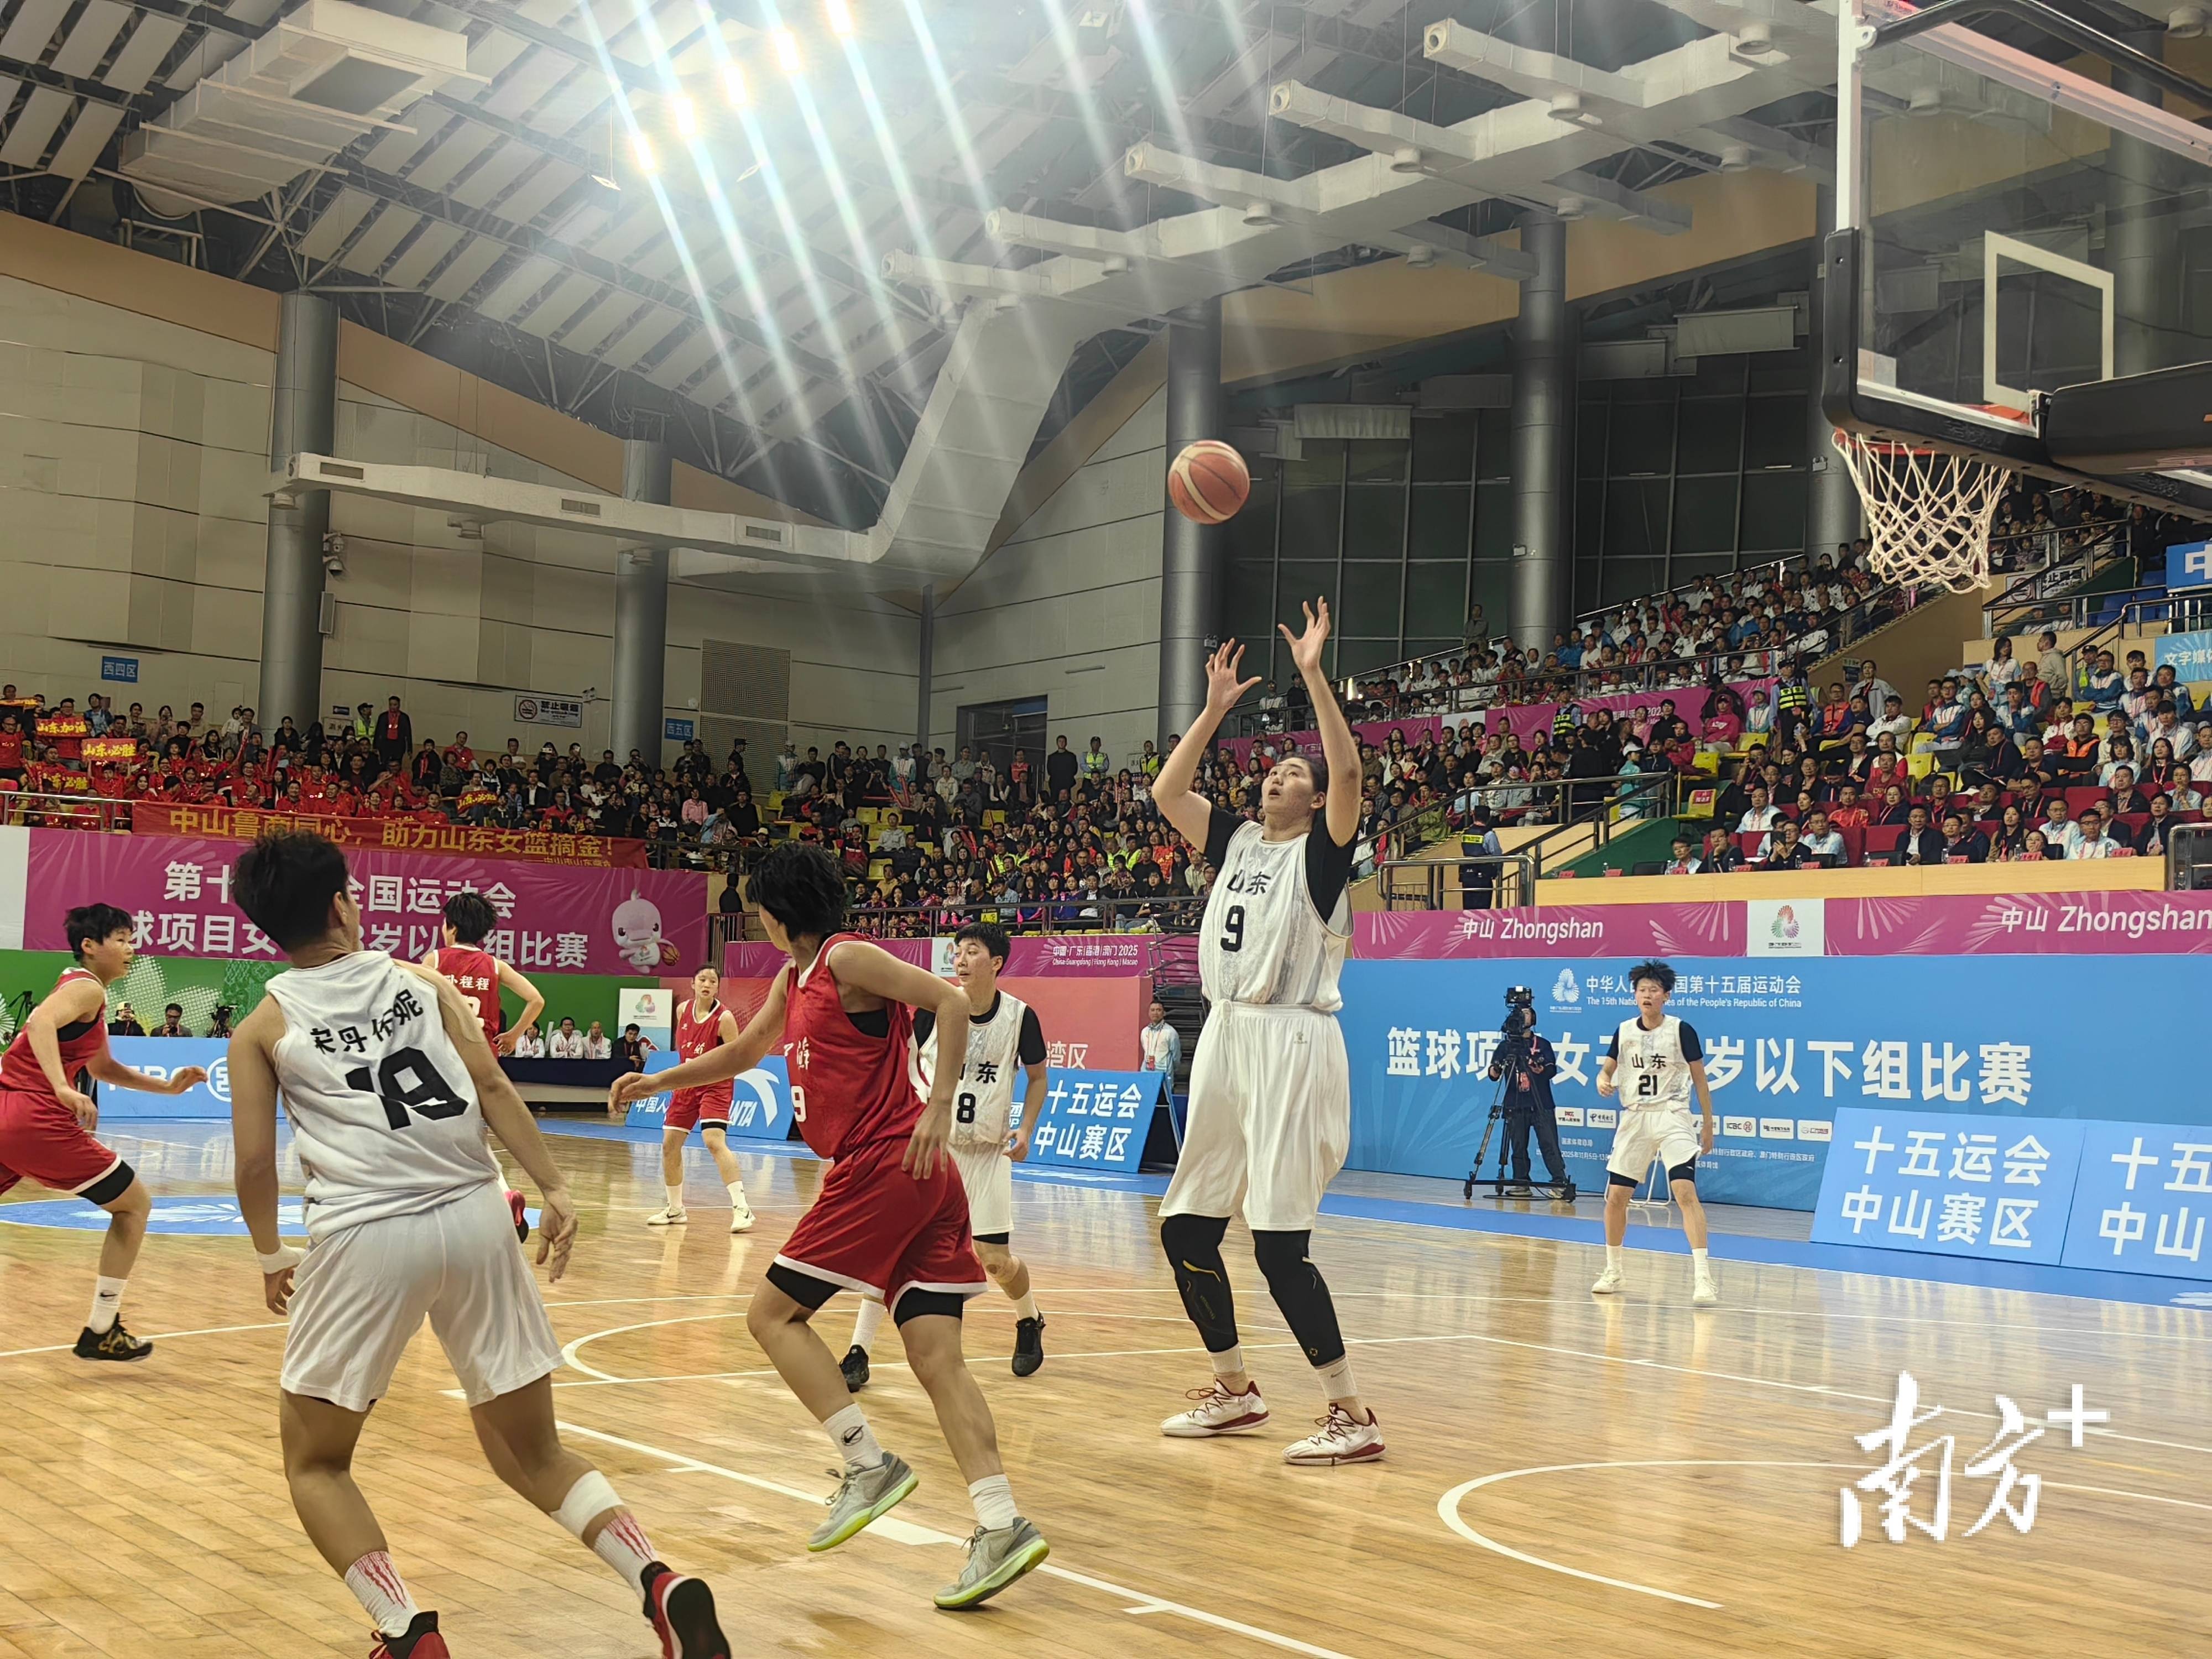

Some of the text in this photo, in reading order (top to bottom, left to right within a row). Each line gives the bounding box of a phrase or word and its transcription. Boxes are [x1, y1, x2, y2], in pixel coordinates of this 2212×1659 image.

[104, 661, 137, 677] 西四区
[37, 721, 87, 734] 山东加油
[84, 743, 136, 757] 山东必胜
[164, 860, 516, 920] 第十全国运会
[1227, 869, 1271, 895] 山东
[1220, 905, 1245, 952] 9
[1463, 917, 1603, 945] 中山 Zhongshan
[2001, 904, 2212, 938] 中山 Zhongshan
[1118, 945, 1138, 956] 2025
[1586, 974, 1801, 995] 中华人国第十五届运动会
[1587, 997, 1600, 1005] The
[1601, 997, 1618, 1005] 15th
[1619, 997, 1638, 1006] Natio
[1677, 998, 1686, 1007] of
[1687, 998, 1699, 1007] the
[1700, 998, 1731, 1009] People's
[1734, 999, 1767, 1009] Republic
[1769, 999, 1777, 1008] of
[1778, 999, 1802, 1008] China
[959, 1061, 999, 1084] 东
[1386, 1026, 2032, 1105] 篮球项女岁以下组比赛
[1632, 1053, 1667, 1069] 山东
[345, 1046, 469, 1130] 19
[1047, 1079, 1142, 1119] 十五运会
[1639, 1074, 1657, 1095] 21
[791, 1086, 806, 1122] 9
[956, 1092, 976, 1123] 8
[1034, 1121, 1132, 1161] 中山赛区
[1854, 1126, 2051, 1186] 十五运会
[2111, 1137, 2212, 1193] 十五
[1841, 1185, 2039, 1248] 中山赛区
[2099, 1202, 2204, 1261] 中山
